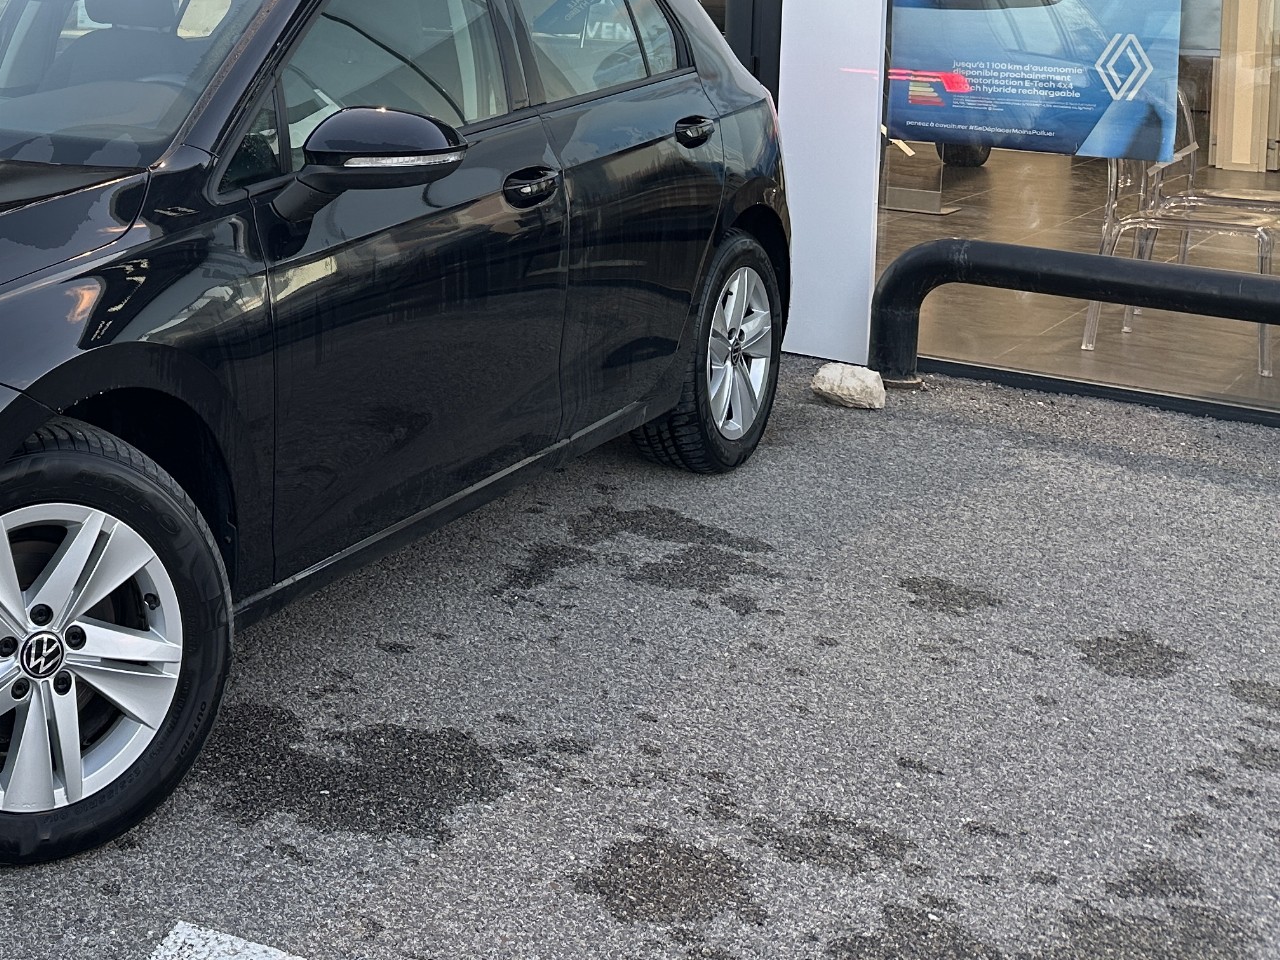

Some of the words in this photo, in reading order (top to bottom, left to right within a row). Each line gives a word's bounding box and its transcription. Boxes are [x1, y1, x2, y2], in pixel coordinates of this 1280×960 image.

[953, 68, 999, 78] disponible
[1000, 71, 1072, 82] prochainement
[982, 85, 1017, 94] hybride
[1018, 88, 1081, 98] rechargeable
